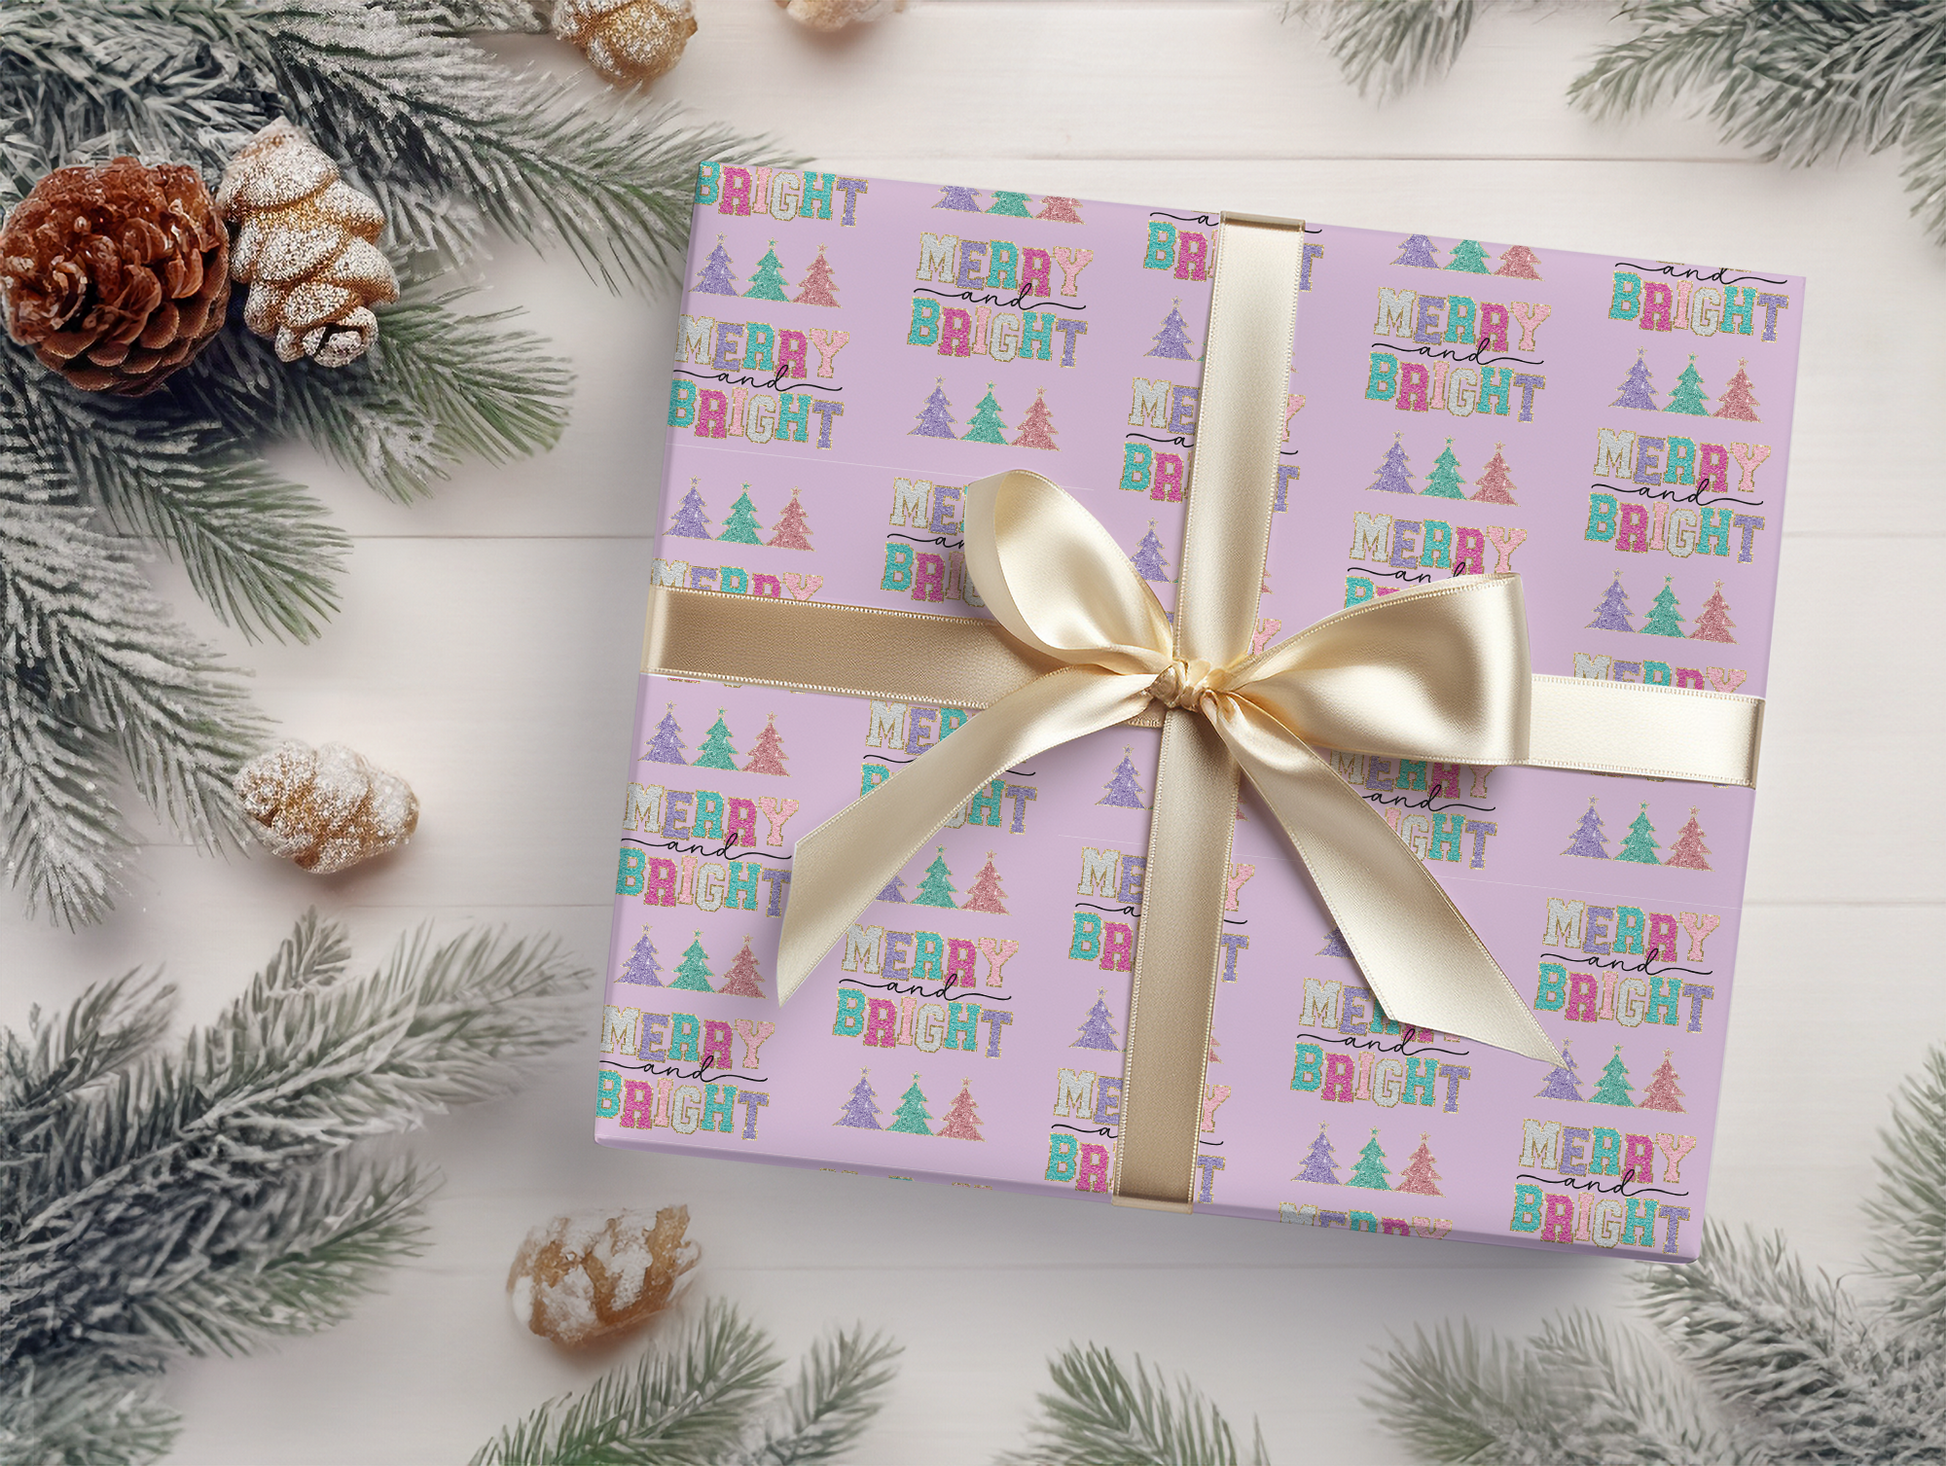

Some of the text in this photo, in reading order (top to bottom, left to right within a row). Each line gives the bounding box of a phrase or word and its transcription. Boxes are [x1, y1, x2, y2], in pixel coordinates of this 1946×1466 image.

[694, 161, 868, 227] BRIGHT
[916, 232, 1094, 298] MERRY
[906, 296, 1088, 368] BRIGHT
[1374, 286, 1552, 353] MERRY
[1608, 270, 1789, 343] BRIGHT
[674, 314, 850, 380] MERRY
[667, 378, 845, 450] BRIGHT
[1364, 352, 1546, 423] BRIGHT
[1592, 428, 1770, 494] MERRY
[1349, 511, 1527, 575] MERRY
[1584, 492, 1766, 564] BRIGHT
[623, 782, 799, 848] MERRY
[615, 847, 792, 918] BRIGHT
[1077, 846, 1255, 912] MEY
[840, 922, 1018, 989] MERRY
[1542, 896, 1720, 963] MERRY
[832, 988, 1014, 1059] BRIGHT
[1534, 962, 1716, 1033] BRIGHT
[600, 1004, 775, 1070] MERRY
[596, 1069, 770, 1140] BRIGHT
[1053, 1068, 1231, 1133] MEY
[1290, 1042, 1472, 1114] BRIGHT
[1518, 1118, 1696, 1184] MERRY
[1510, 1182, 1692, 1254] BRIGHT
